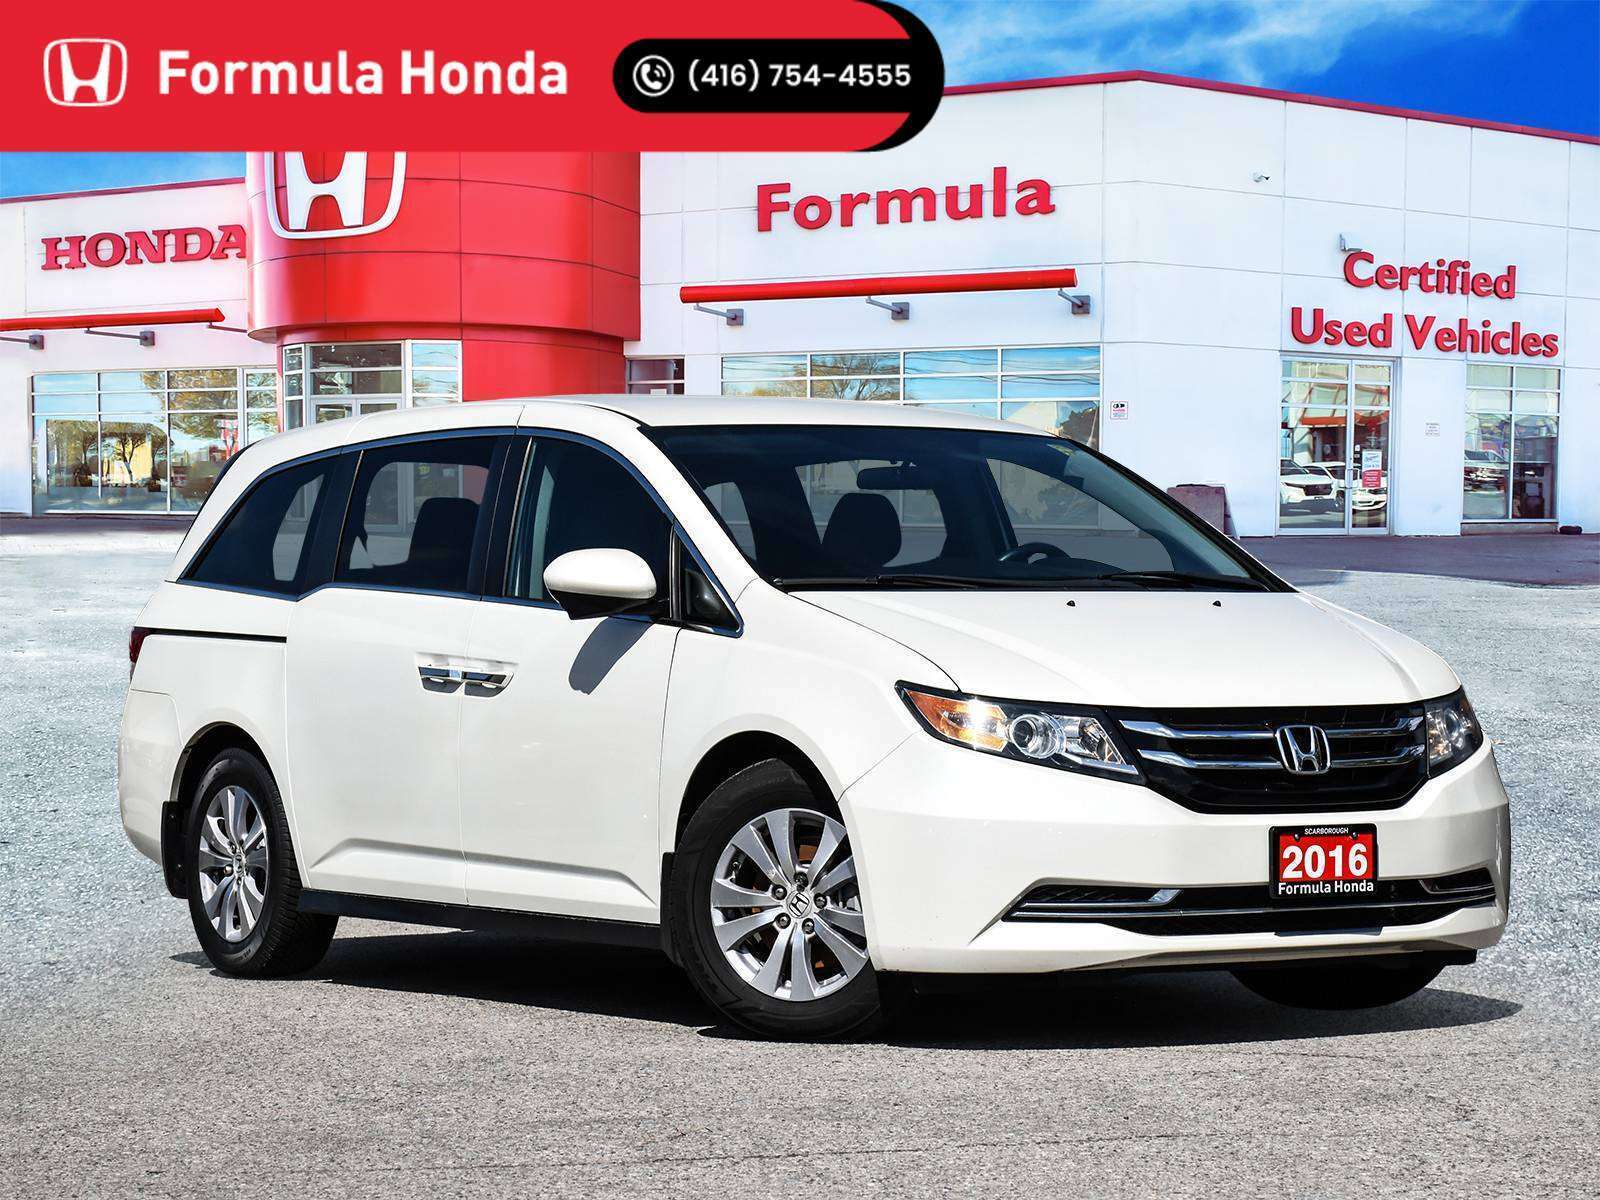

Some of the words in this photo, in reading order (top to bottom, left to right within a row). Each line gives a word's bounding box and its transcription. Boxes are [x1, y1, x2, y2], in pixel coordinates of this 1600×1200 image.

[757, 166, 1056, 232] Formula
[41, 224, 247, 270] HONDA
[1343, 251, 1517, 299] Certified
[1291, 306, 1393, 348] Used
[1404, 314, 1560, 358] Vehicles
[1304, 827, 1349, 835] SCARBOROUGH
[1282, 843, 1368, 879] 2016
[1278, 881, 1332, 895] Formula
[1334, 880, 1374, 893] Honda
